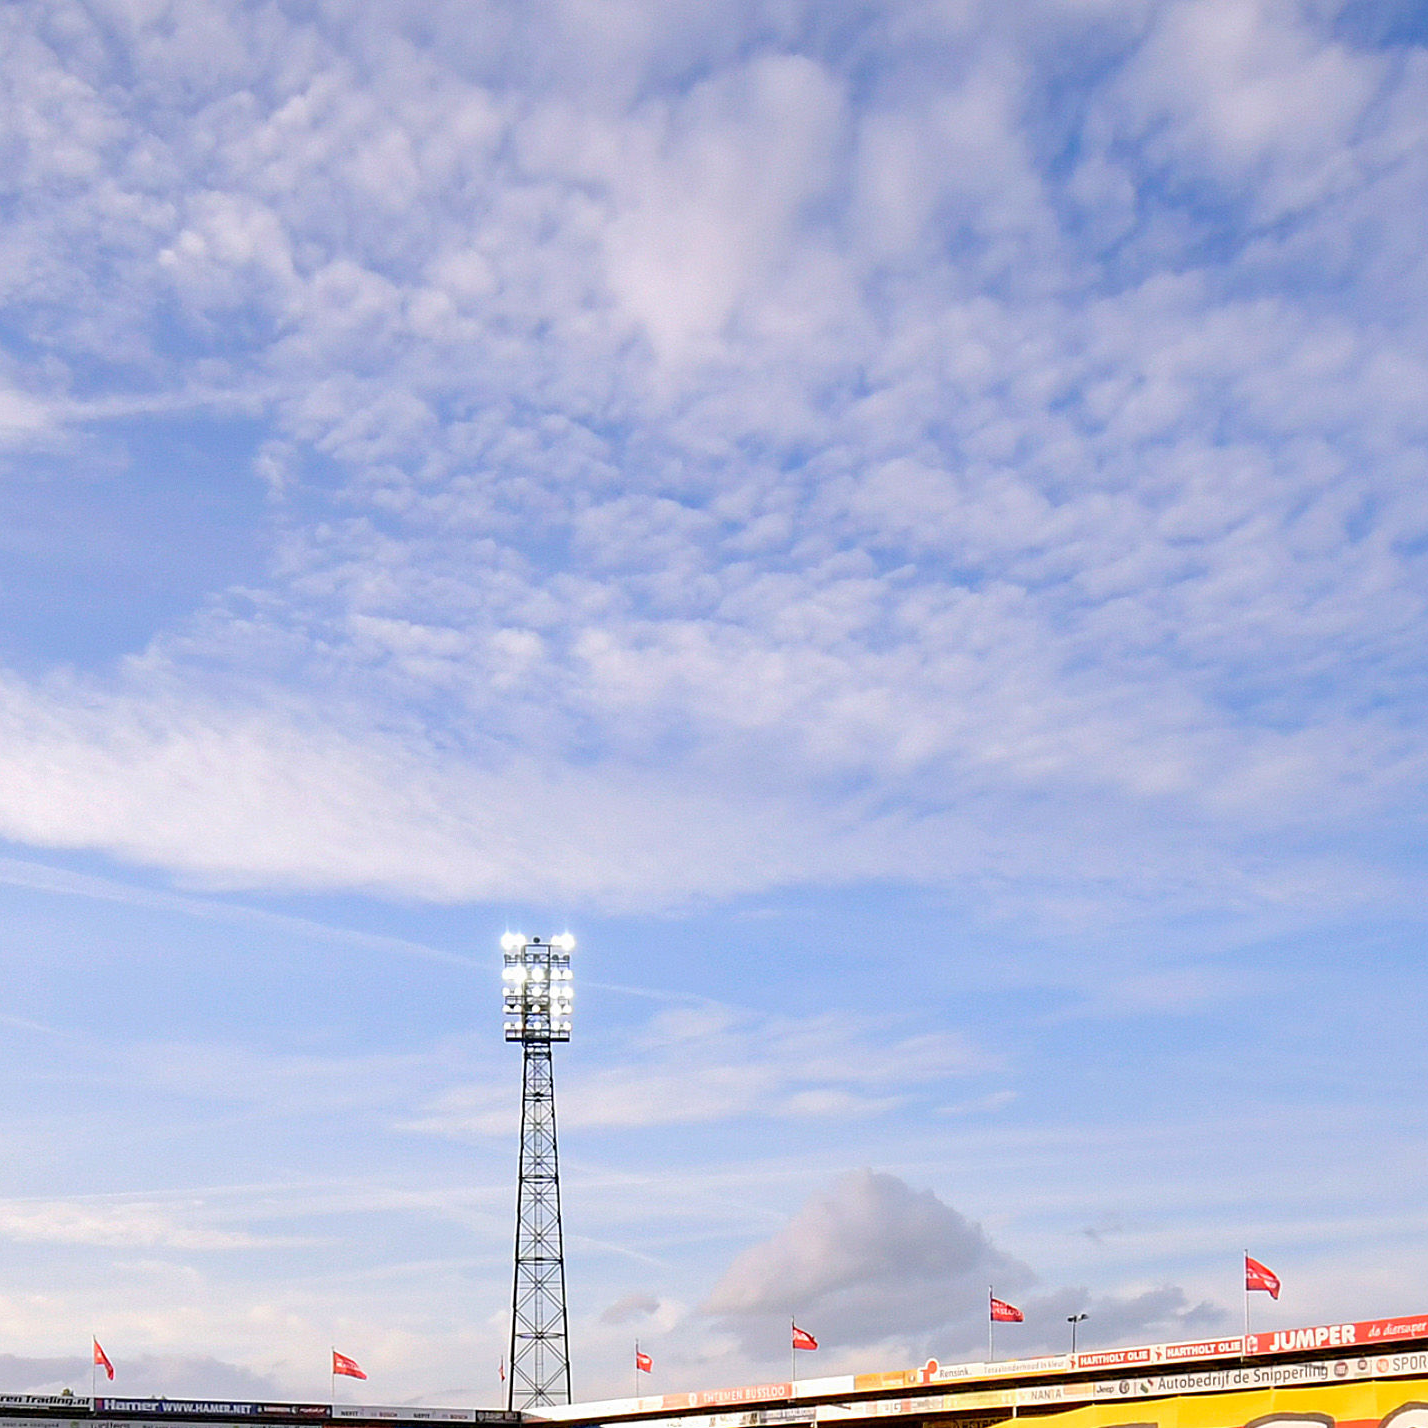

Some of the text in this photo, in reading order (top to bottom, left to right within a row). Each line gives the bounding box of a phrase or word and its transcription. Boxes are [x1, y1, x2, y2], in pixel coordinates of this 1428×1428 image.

[1269, 1324, 1356, 1352] JUMPER
[1079, 1350, 1148, 1365] HARTHOLT OLIE
[1166, 1341, 1241, 1358] HARTHOLT OLIE
[1158, 1371, 1230, 1391] Autobedrijf
[1234, 1371, 1249, 1383] de
[1254, 1363, 1328, 1385] Snipperling
[26, 1395, 90, 1406] Trading.nl
[746, 1386, 785, 1400] BUSSLOO
[104, 1399, 160, 1411] Hamer
[162, 1402, 251, 1415] WWW.HAMER.NET
